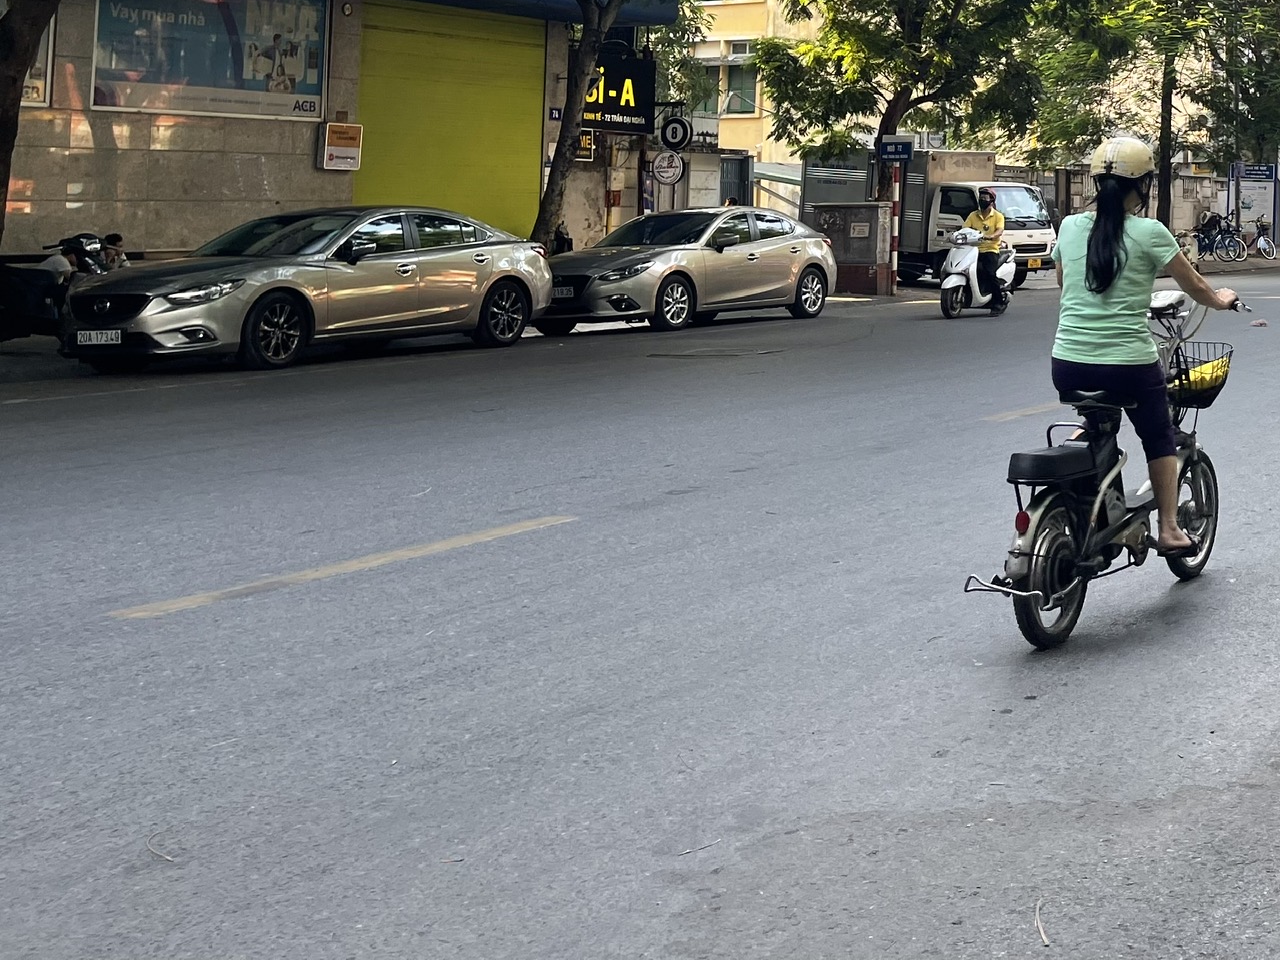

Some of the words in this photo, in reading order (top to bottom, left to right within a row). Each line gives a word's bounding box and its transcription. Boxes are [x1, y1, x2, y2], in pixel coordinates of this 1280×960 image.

[110, 2, 139, 26] Vay
[142, 8, 174, 25] mua
[178, 10, 206, 27] nhà
[293, 99, 316, 113] ACB
[671, 126, 678, 140] 8
